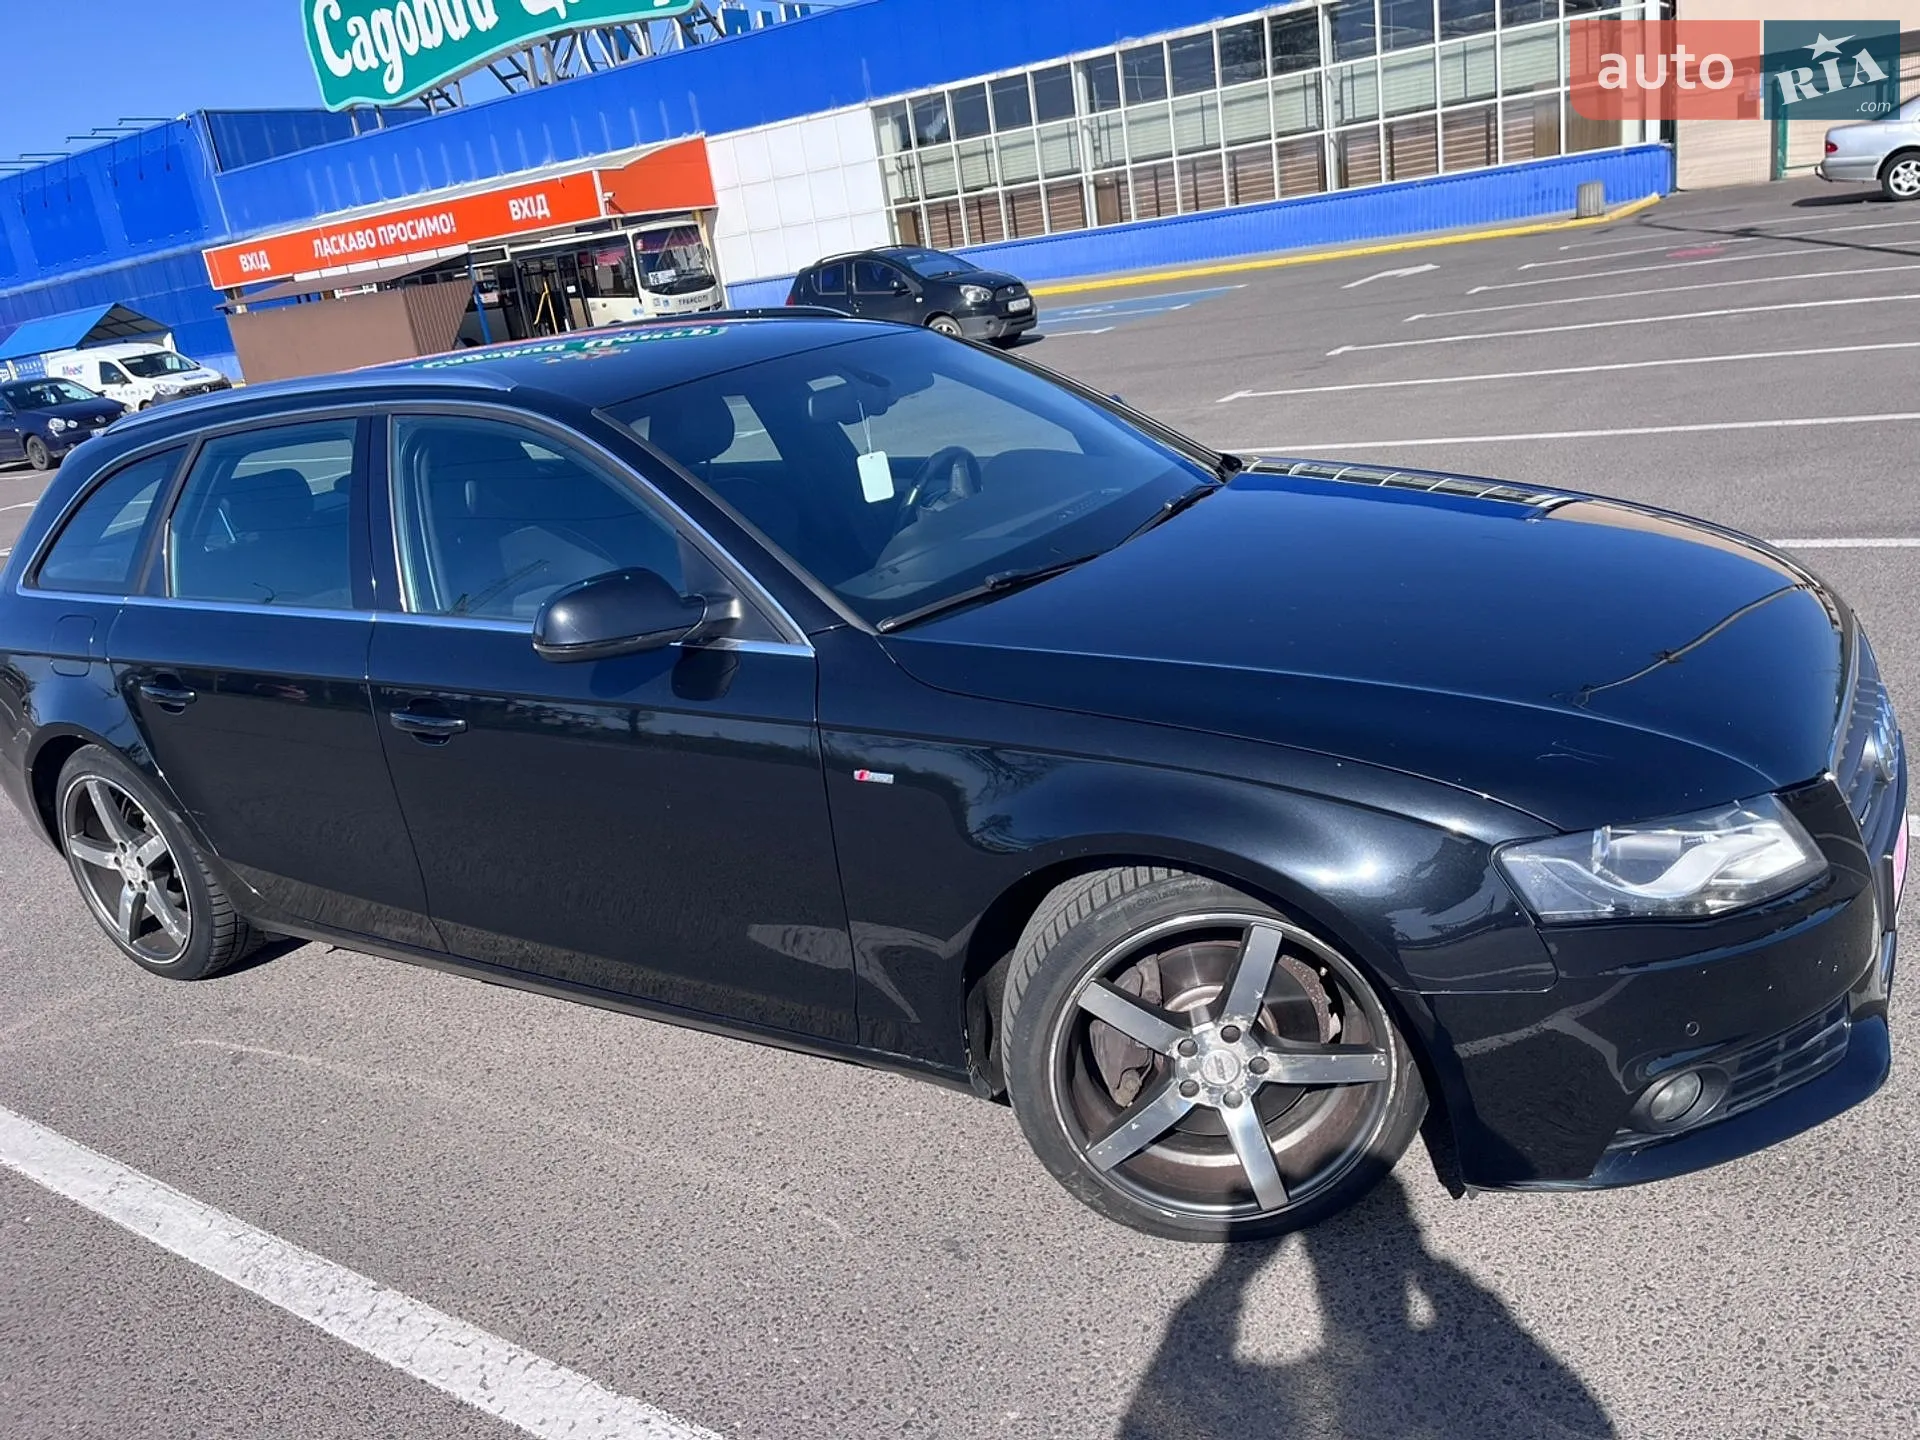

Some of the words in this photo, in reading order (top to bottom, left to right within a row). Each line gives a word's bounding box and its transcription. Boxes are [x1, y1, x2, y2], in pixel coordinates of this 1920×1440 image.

[509, 192, 550, 222] ВХІД
[312, 228, 377, 258] ЛАСКАВО
[377, 212, 457, 247] ПРОСИМО!
[239, 249, 271, 273] ВХІД
